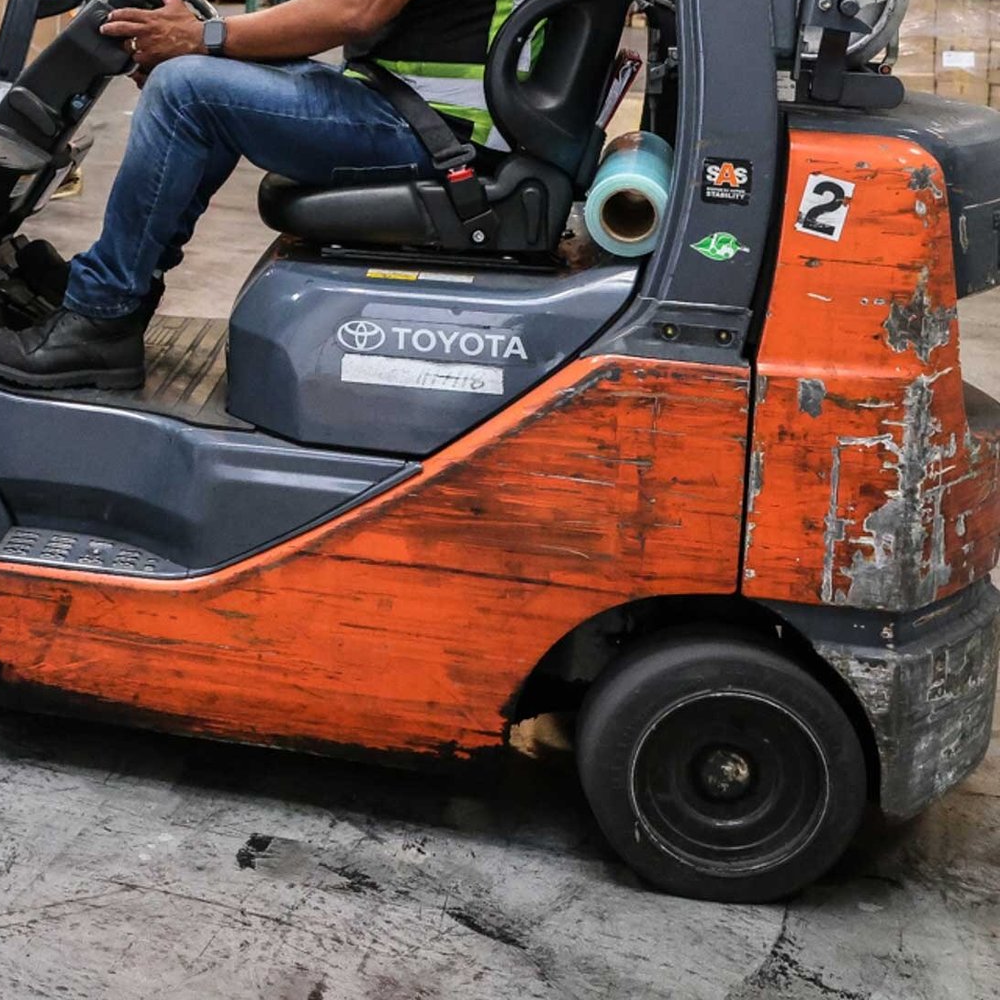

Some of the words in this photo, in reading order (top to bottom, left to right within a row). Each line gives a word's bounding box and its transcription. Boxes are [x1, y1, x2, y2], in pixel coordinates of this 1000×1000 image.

[706, 162, 748, 187] SAS
[706, 191, 745, 199] STABILITY
[802, 181, 846, 236] 2
[391, 327, 528, 360] TOYOTA
